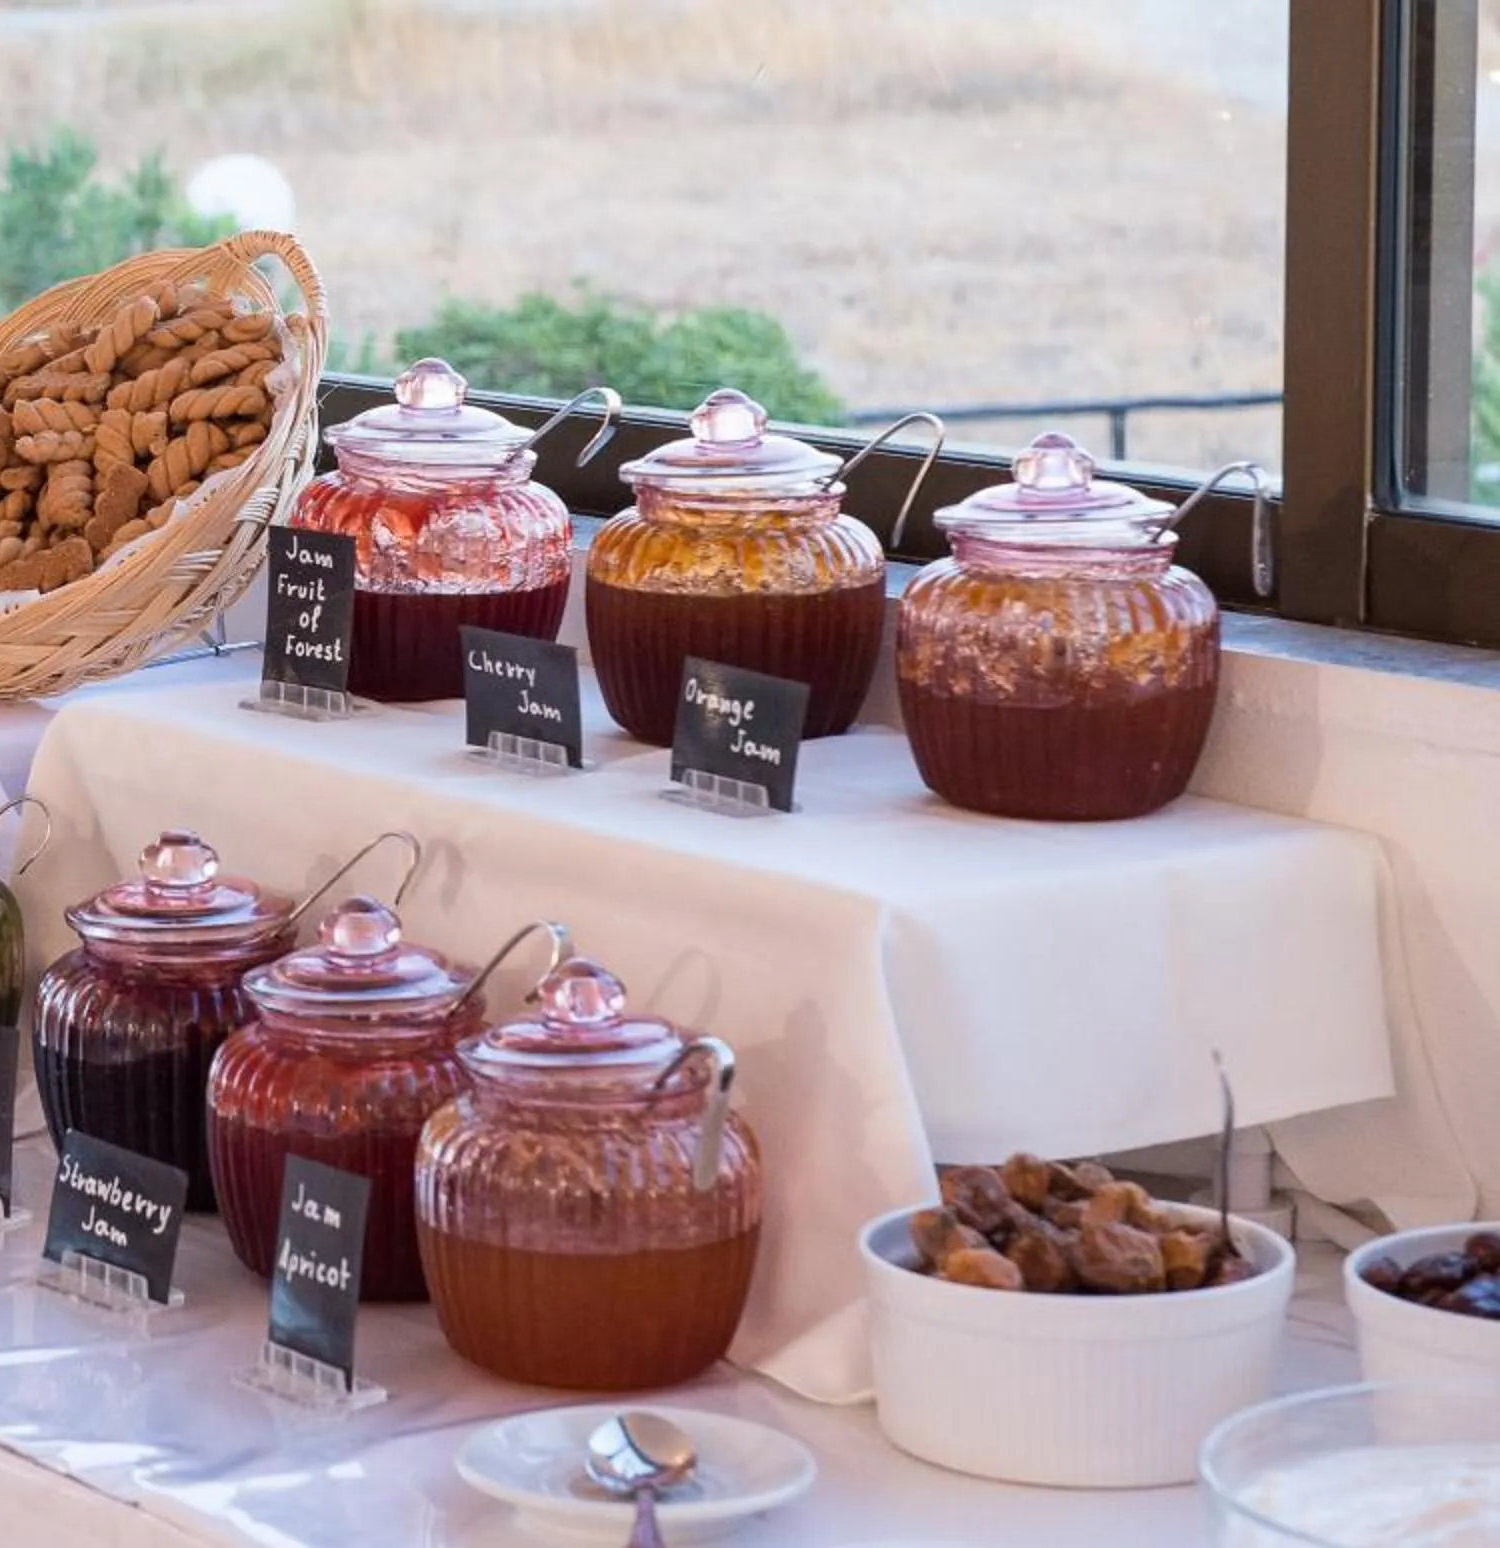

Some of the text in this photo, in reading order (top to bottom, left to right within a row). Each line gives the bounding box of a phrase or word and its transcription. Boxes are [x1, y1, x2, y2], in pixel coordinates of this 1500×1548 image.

[285, 535, 333, 569] Jam
[276, 573, 326, 601] Fruit
[299, 604, 322, 633] of
[285, 635, 344, 662] Forest
[468, 650, 537, 686] Cherry
[517, 690, 562, 722] Jam
[684, 677, 755, 726] Orange
[729, 729, 781, 766] Jam
[58, 1153, 172, 1234] Strawberry
[291, 1183, 342, 1230] Jam
[81, 1206, 127, 1248] Jam
[277, 1237, 351, 1291] Apricot
